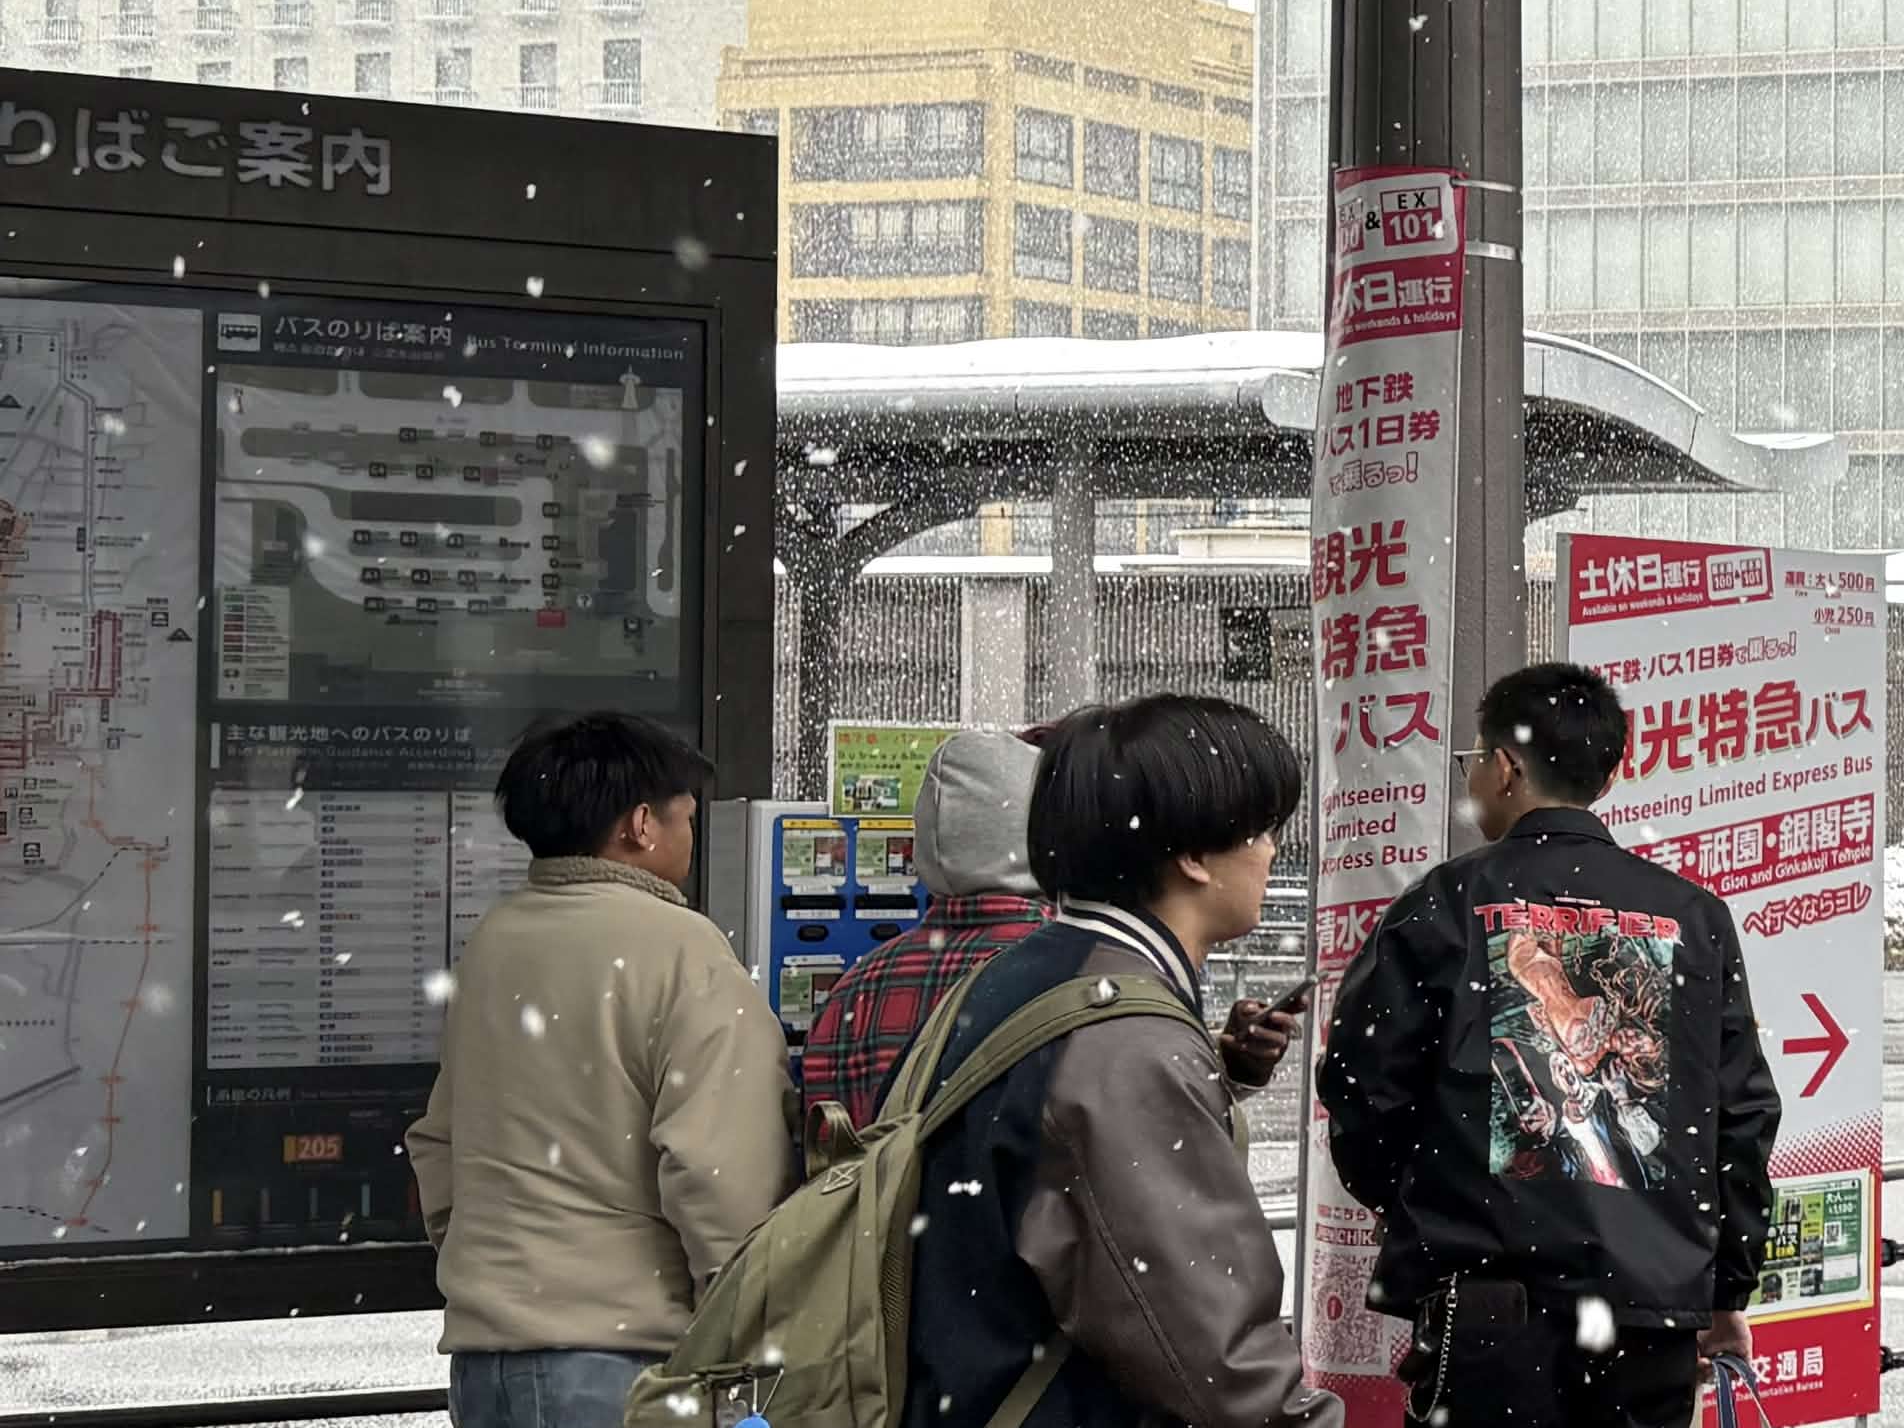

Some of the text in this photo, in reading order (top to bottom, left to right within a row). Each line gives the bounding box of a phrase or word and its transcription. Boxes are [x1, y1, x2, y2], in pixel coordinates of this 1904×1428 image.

[1365, 191, 1426, 230] & EX
[1389, 212, 1438, 241] 101
[275, 316, 452, 347] バスのりば案内
[1413, 309, 1456, 326] holidays
[504, 336, 577, 354] Terminl
[584, 341, 685, 361] Information
[1336, 372, 1414, 414] 地下鉄
[1312, 520, 1408, 602] 観光
[1579, 553, 1702, 600] 土休日運行
[1743, 571, 1761, 584] 101
[1321, 604, 1429, 680] 特急
[226, 725, 472, 742] 主な観光地へのバスのりば
[1334, 691, 1441, 755] バス
[1699, 755, 1873, 806] Limited Express Bus
[1325, 812, 1397, 843] Limited
[1628, 798, 1873, 879] 寺・祇園・銀閣寺
[1381, 843, 1429, 866] Bus
[1721, 874, 1748, 893] Gion
[1751, 869, 1773, 886] and
[1832, 843, 1871, 867] Temple
[1474, 903, 1681, 940] TERRIFIER
[1743, 881, 1872, 937] へ行くならコレ
[299, 1137, 340, 1158] 205
